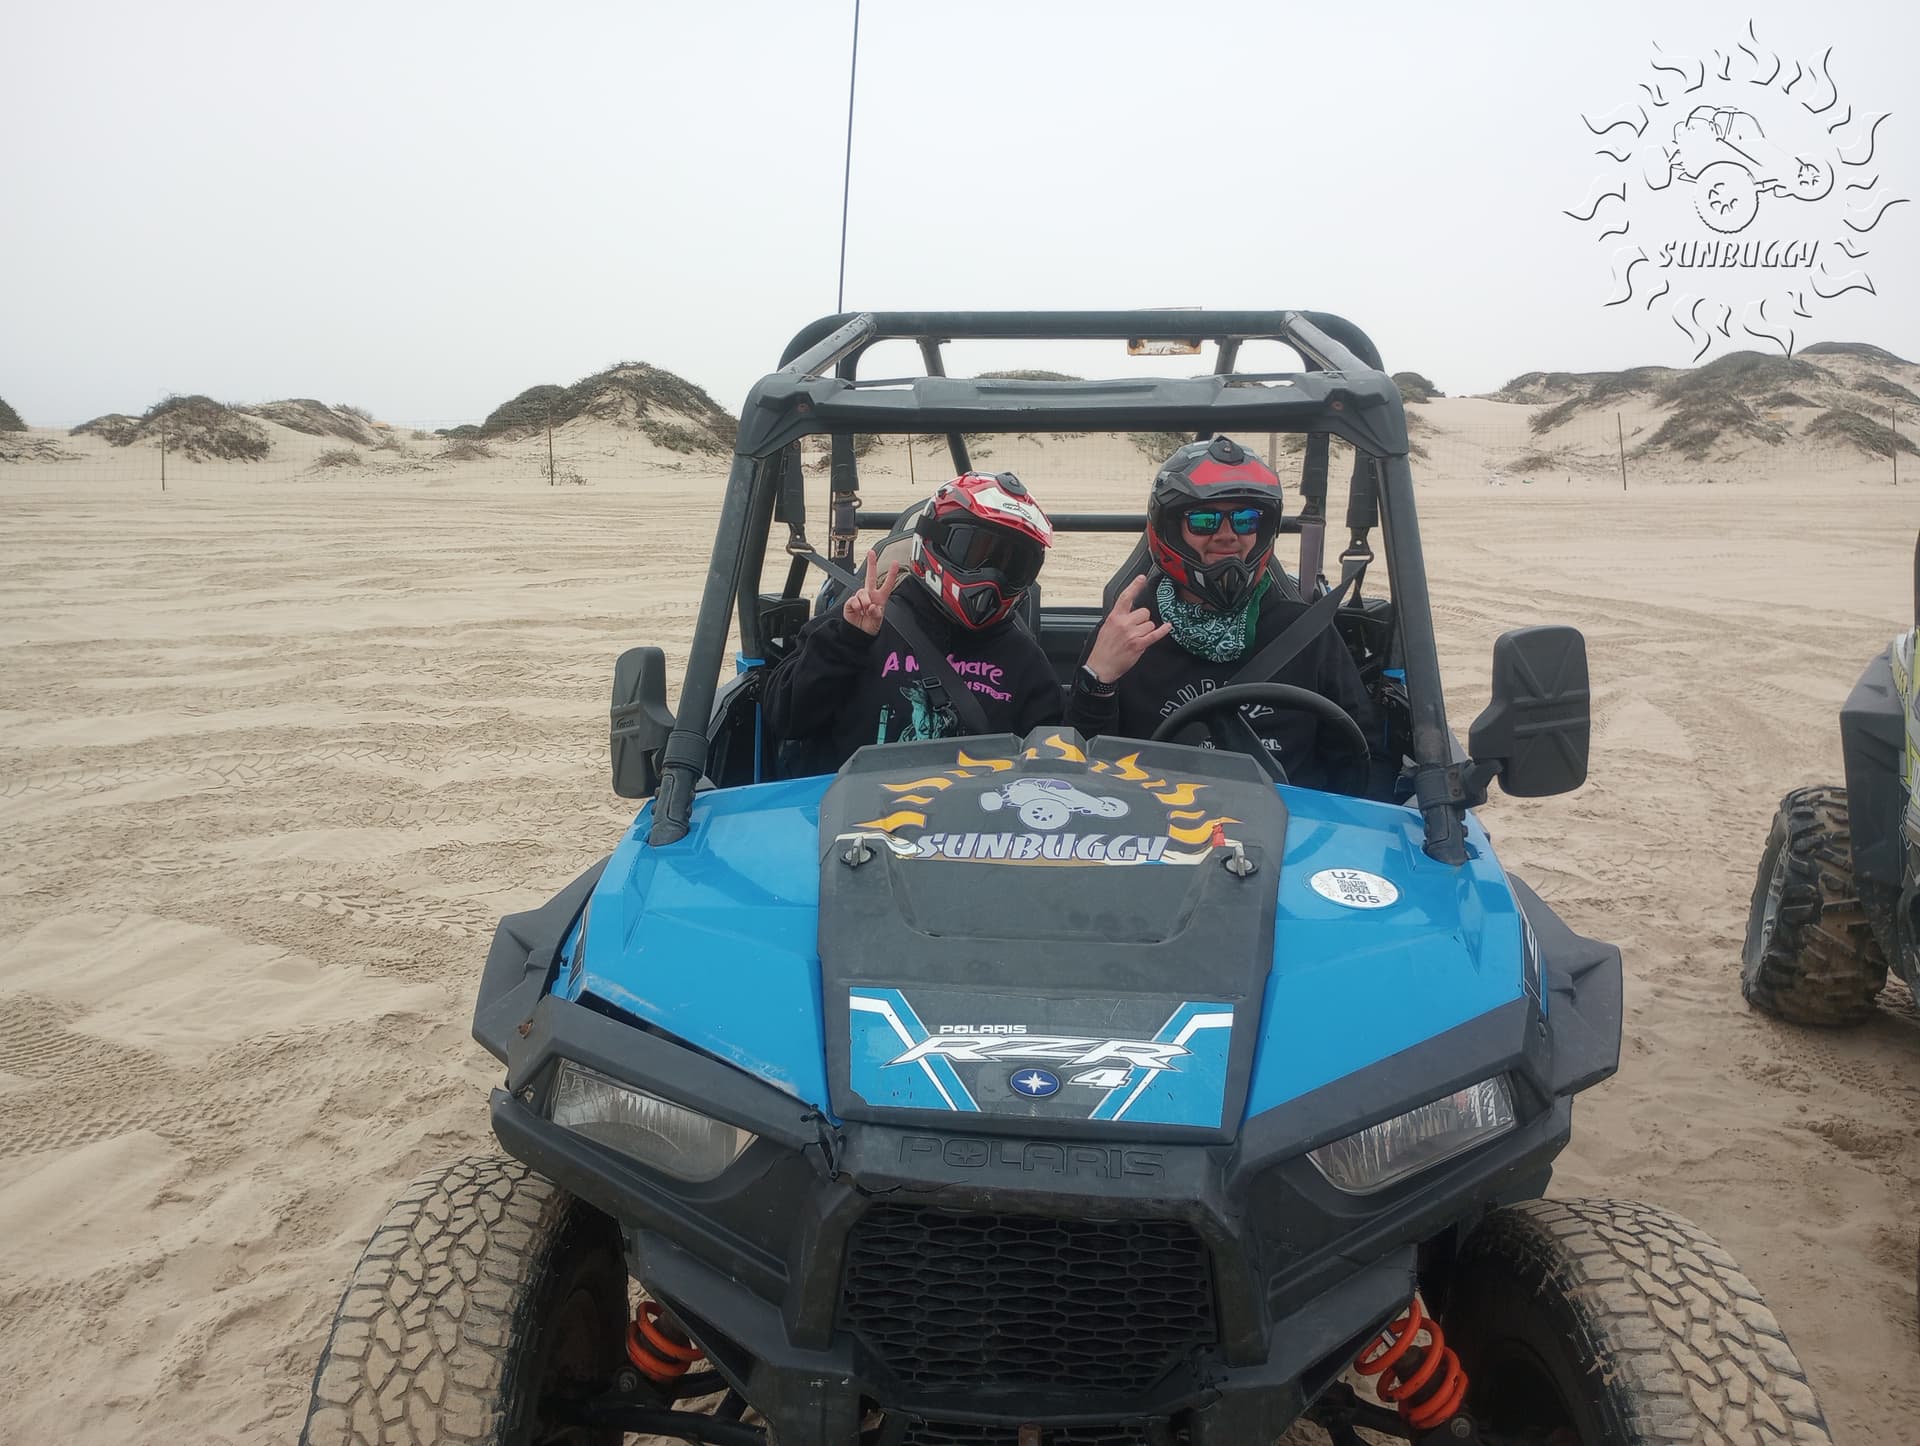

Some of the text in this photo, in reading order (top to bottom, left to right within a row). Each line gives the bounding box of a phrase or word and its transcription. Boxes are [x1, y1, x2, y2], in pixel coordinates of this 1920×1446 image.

[881, 651, 900, 678] A
[915, 832, 1169, 862] SUNBUGGY
[1343, 894, 1381, 904] 405
[939, 1024, 1028, 1035] POLARIS
[880, 1035, 1193, 1073] RZR
[1067, 1067, 1133, 1089] 4
[898, 1135, 1168, 1180] POLARIS
